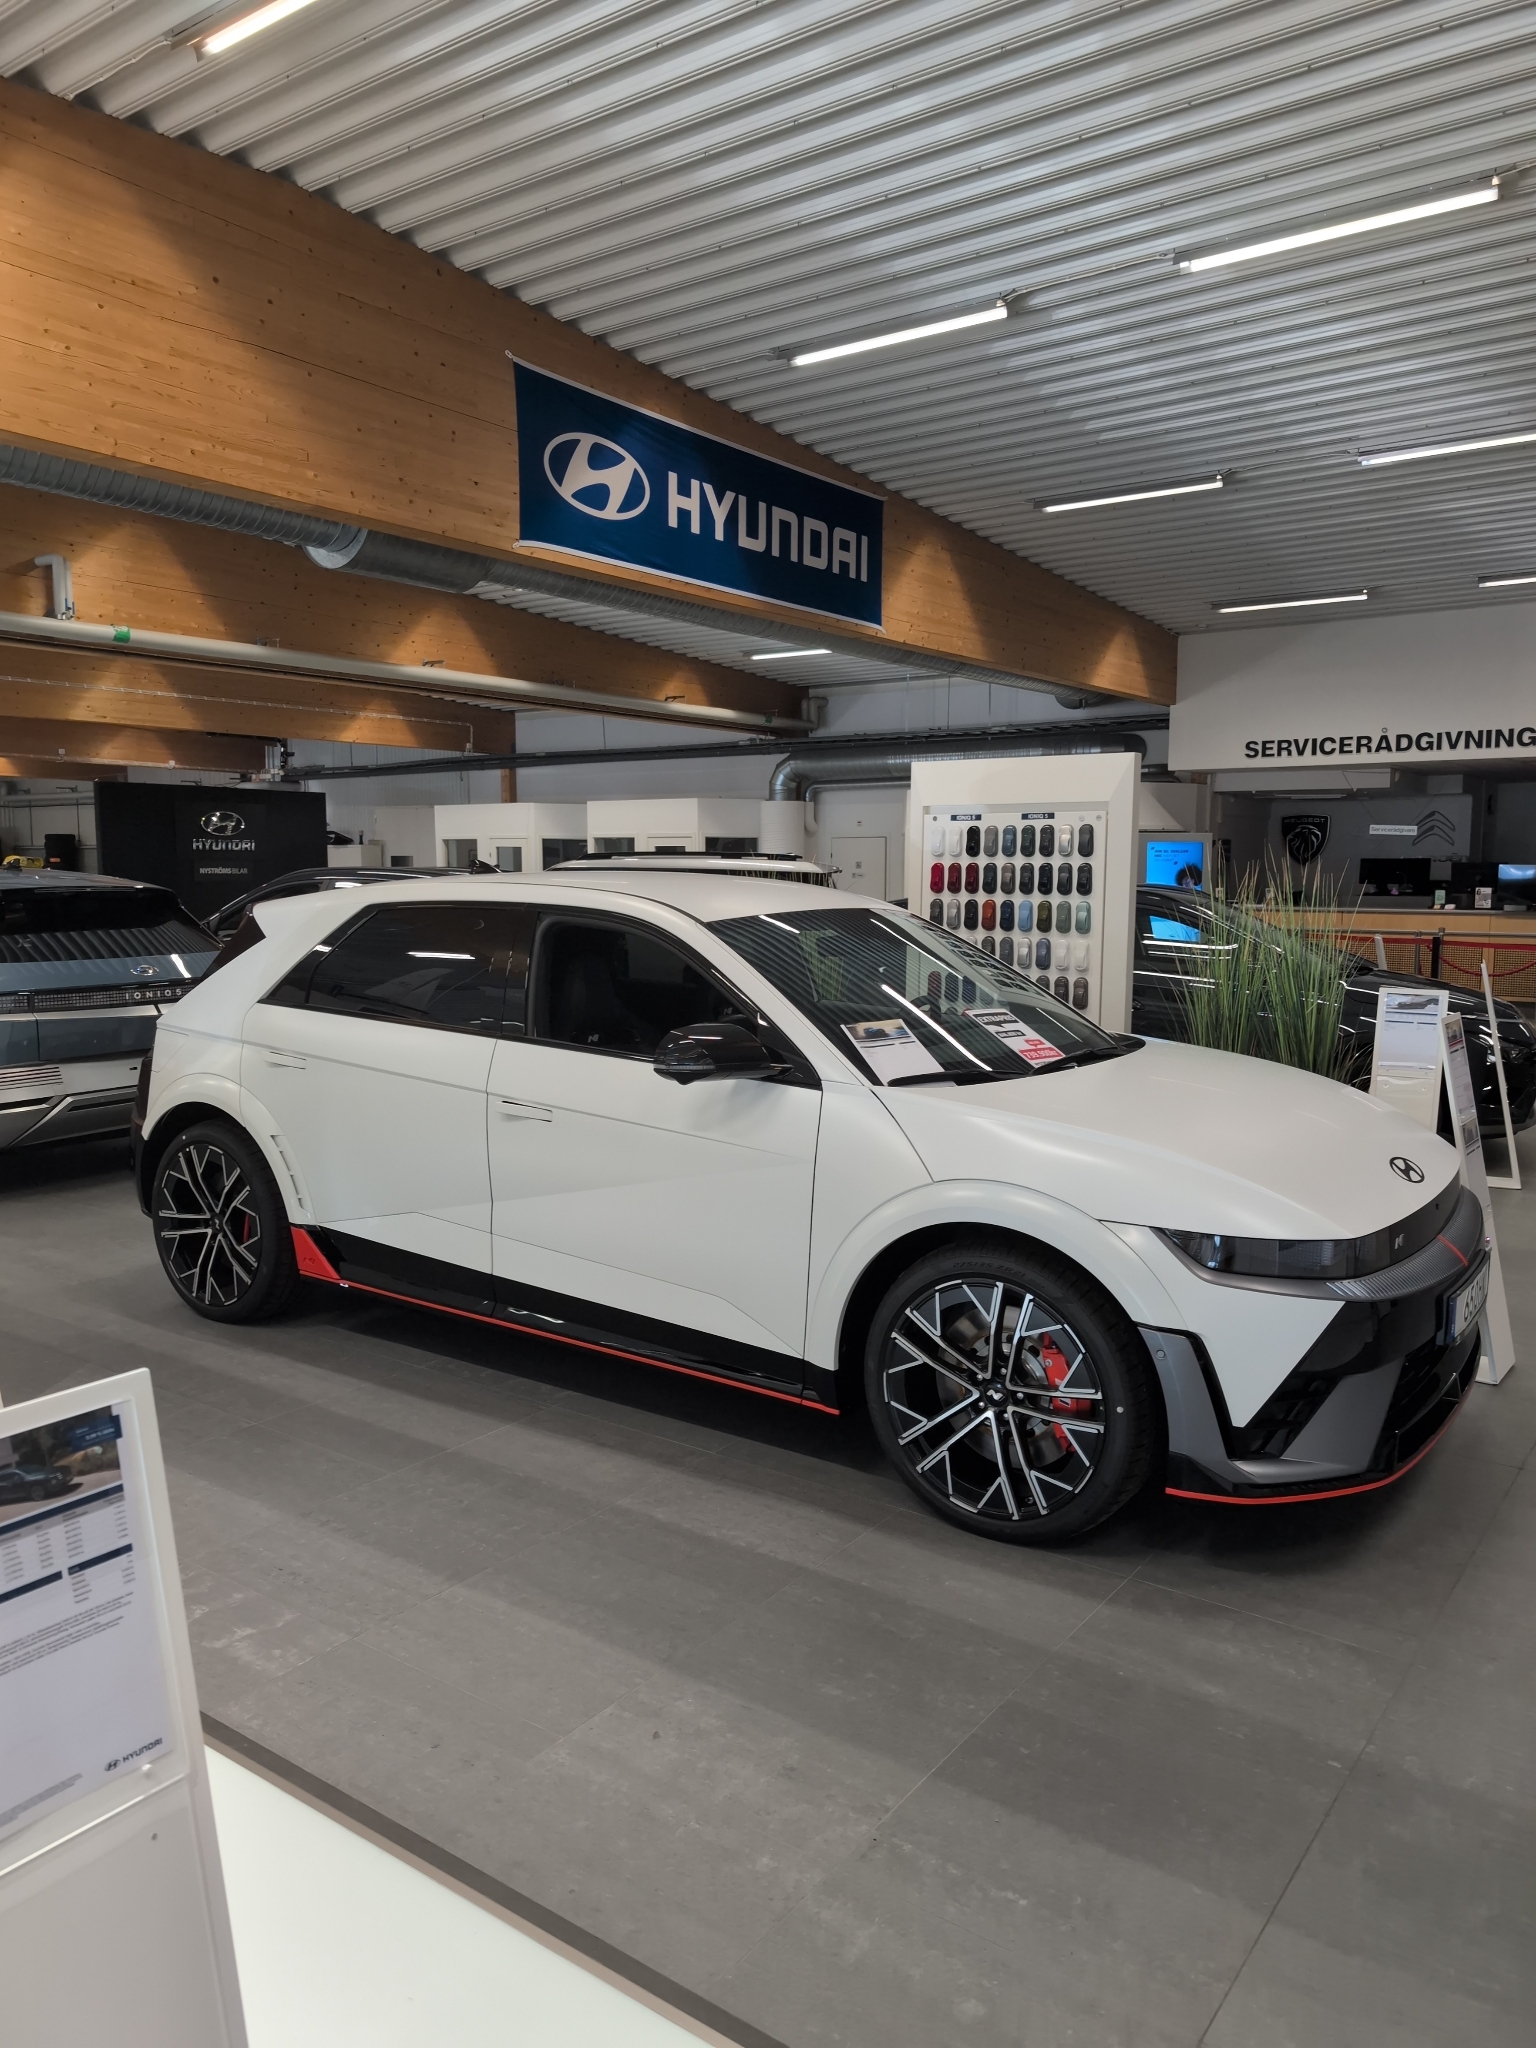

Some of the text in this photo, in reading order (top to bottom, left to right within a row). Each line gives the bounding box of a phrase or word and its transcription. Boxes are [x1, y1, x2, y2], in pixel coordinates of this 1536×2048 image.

[667, 470, 869, 583] HYUNDAI
[1244, 727, 1536, 759] SERVICERÅDGIVNING
[192, 838, 256, 851] HYUNDAI
[122, 1737, 163, 1763] HYUNDAI
